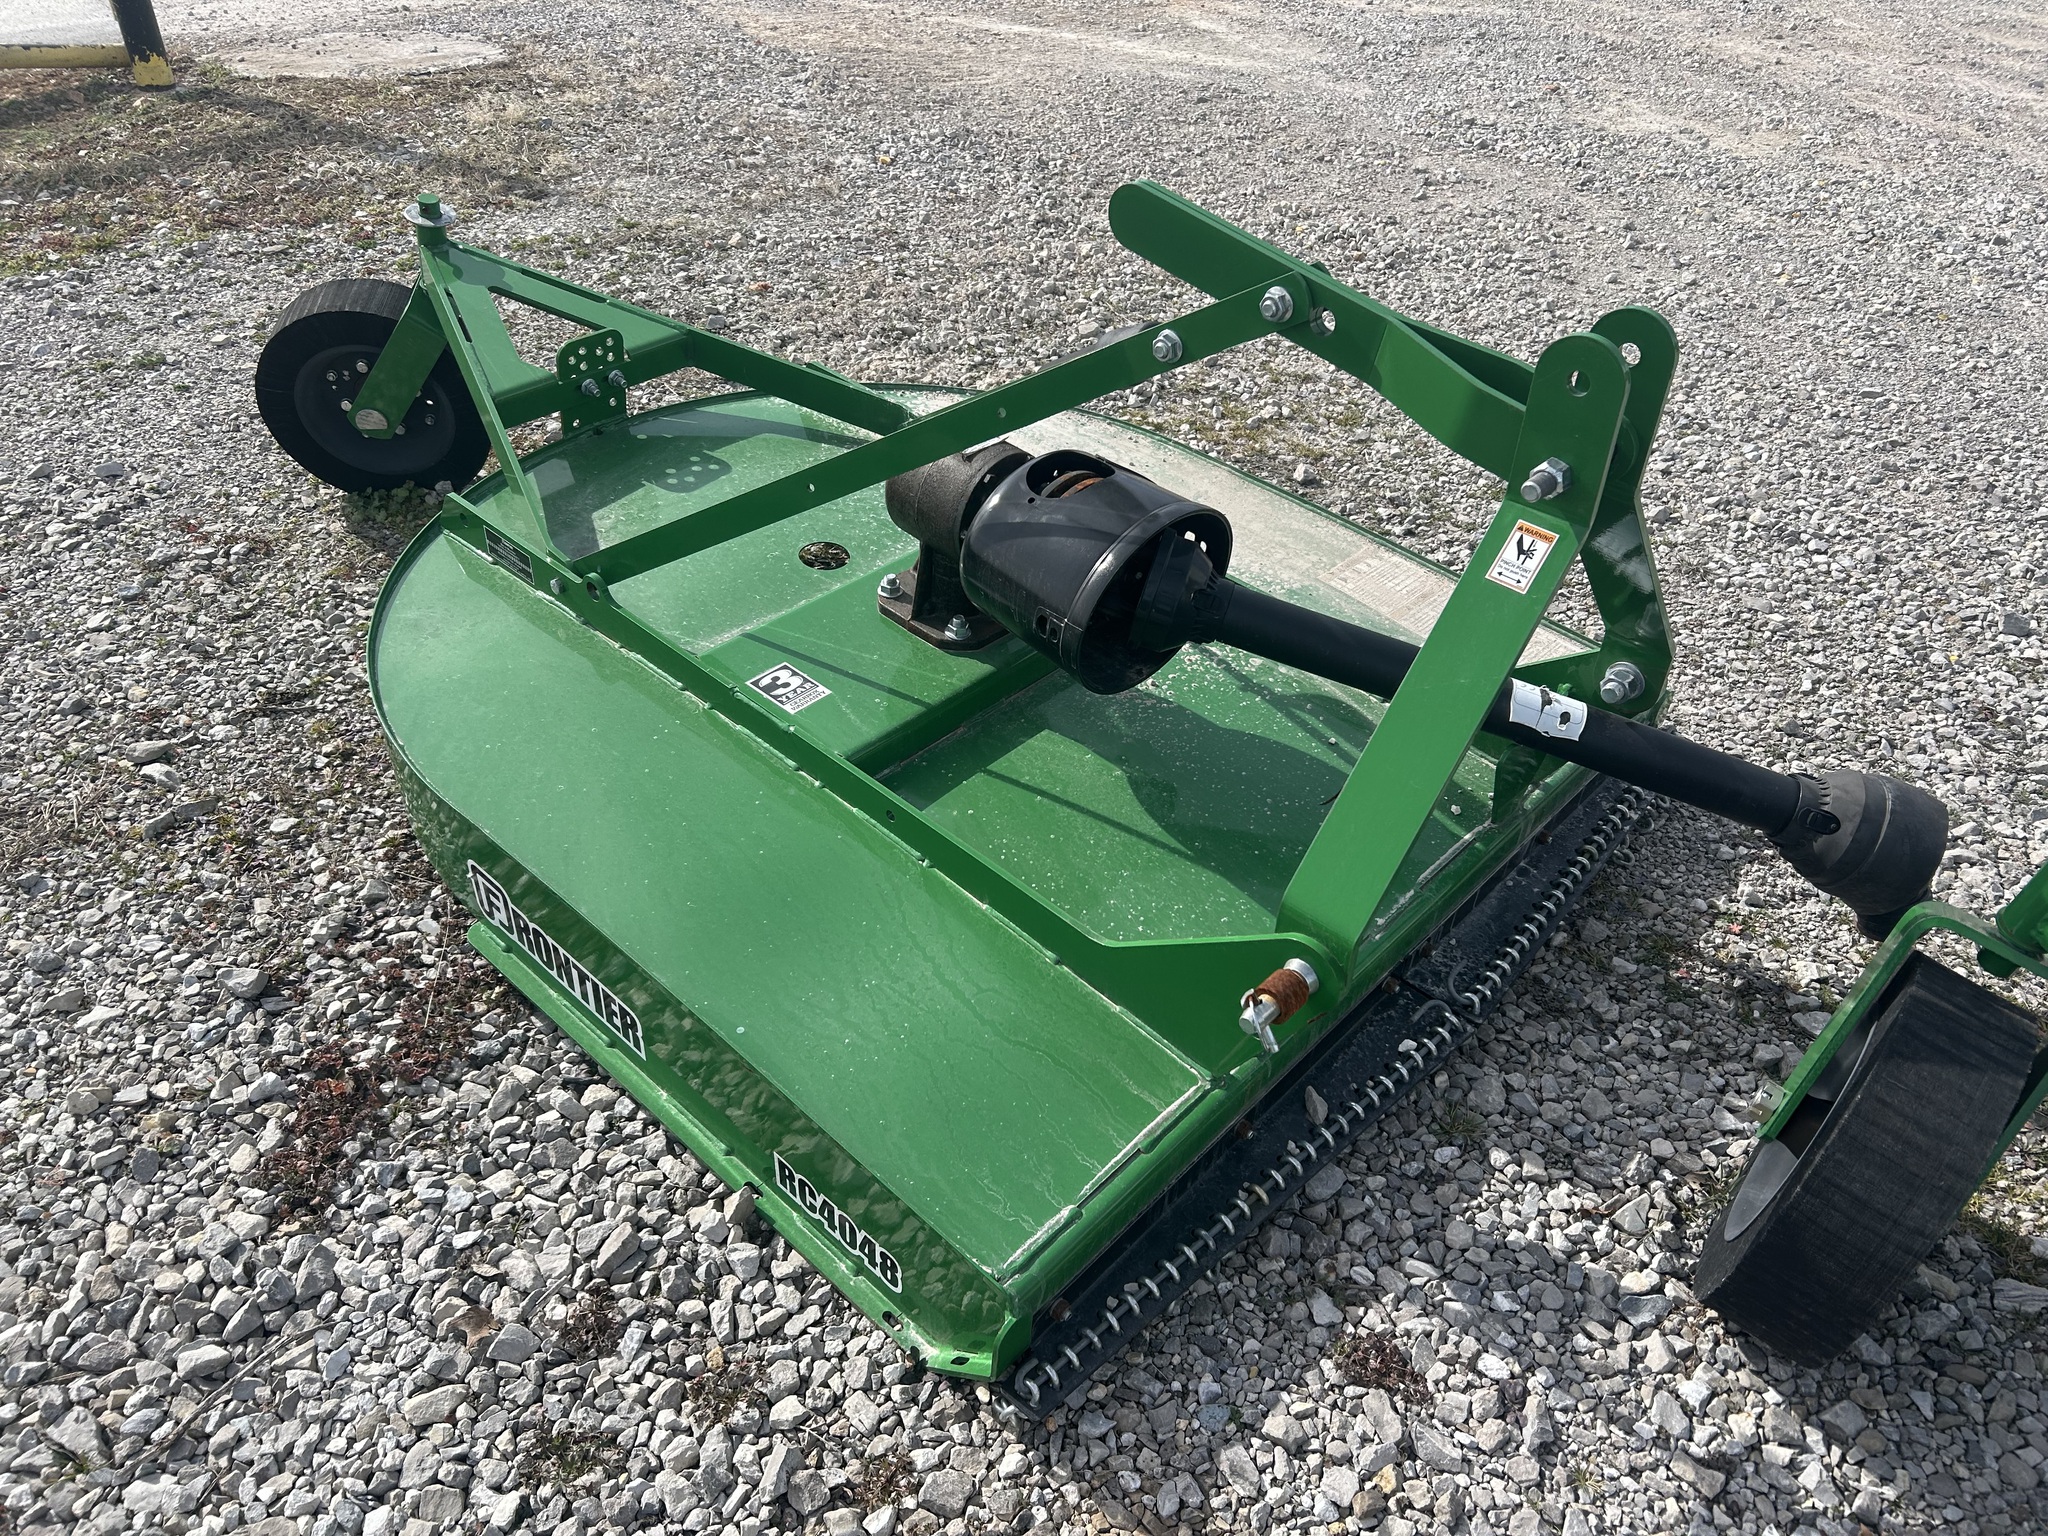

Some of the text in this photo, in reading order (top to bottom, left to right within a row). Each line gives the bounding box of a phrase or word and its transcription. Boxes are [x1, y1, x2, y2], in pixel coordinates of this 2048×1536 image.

[1523, 527, 1554, 543] WARNING
[1500, 558, 1532, 574] PINCH POINT
[758, 668, 804, 696] 3
[776, 681, 815, 702] YEAR
[469, 861, 645, 1058] FRONTIER
[776, 1155, 900, 1290] RC4048
